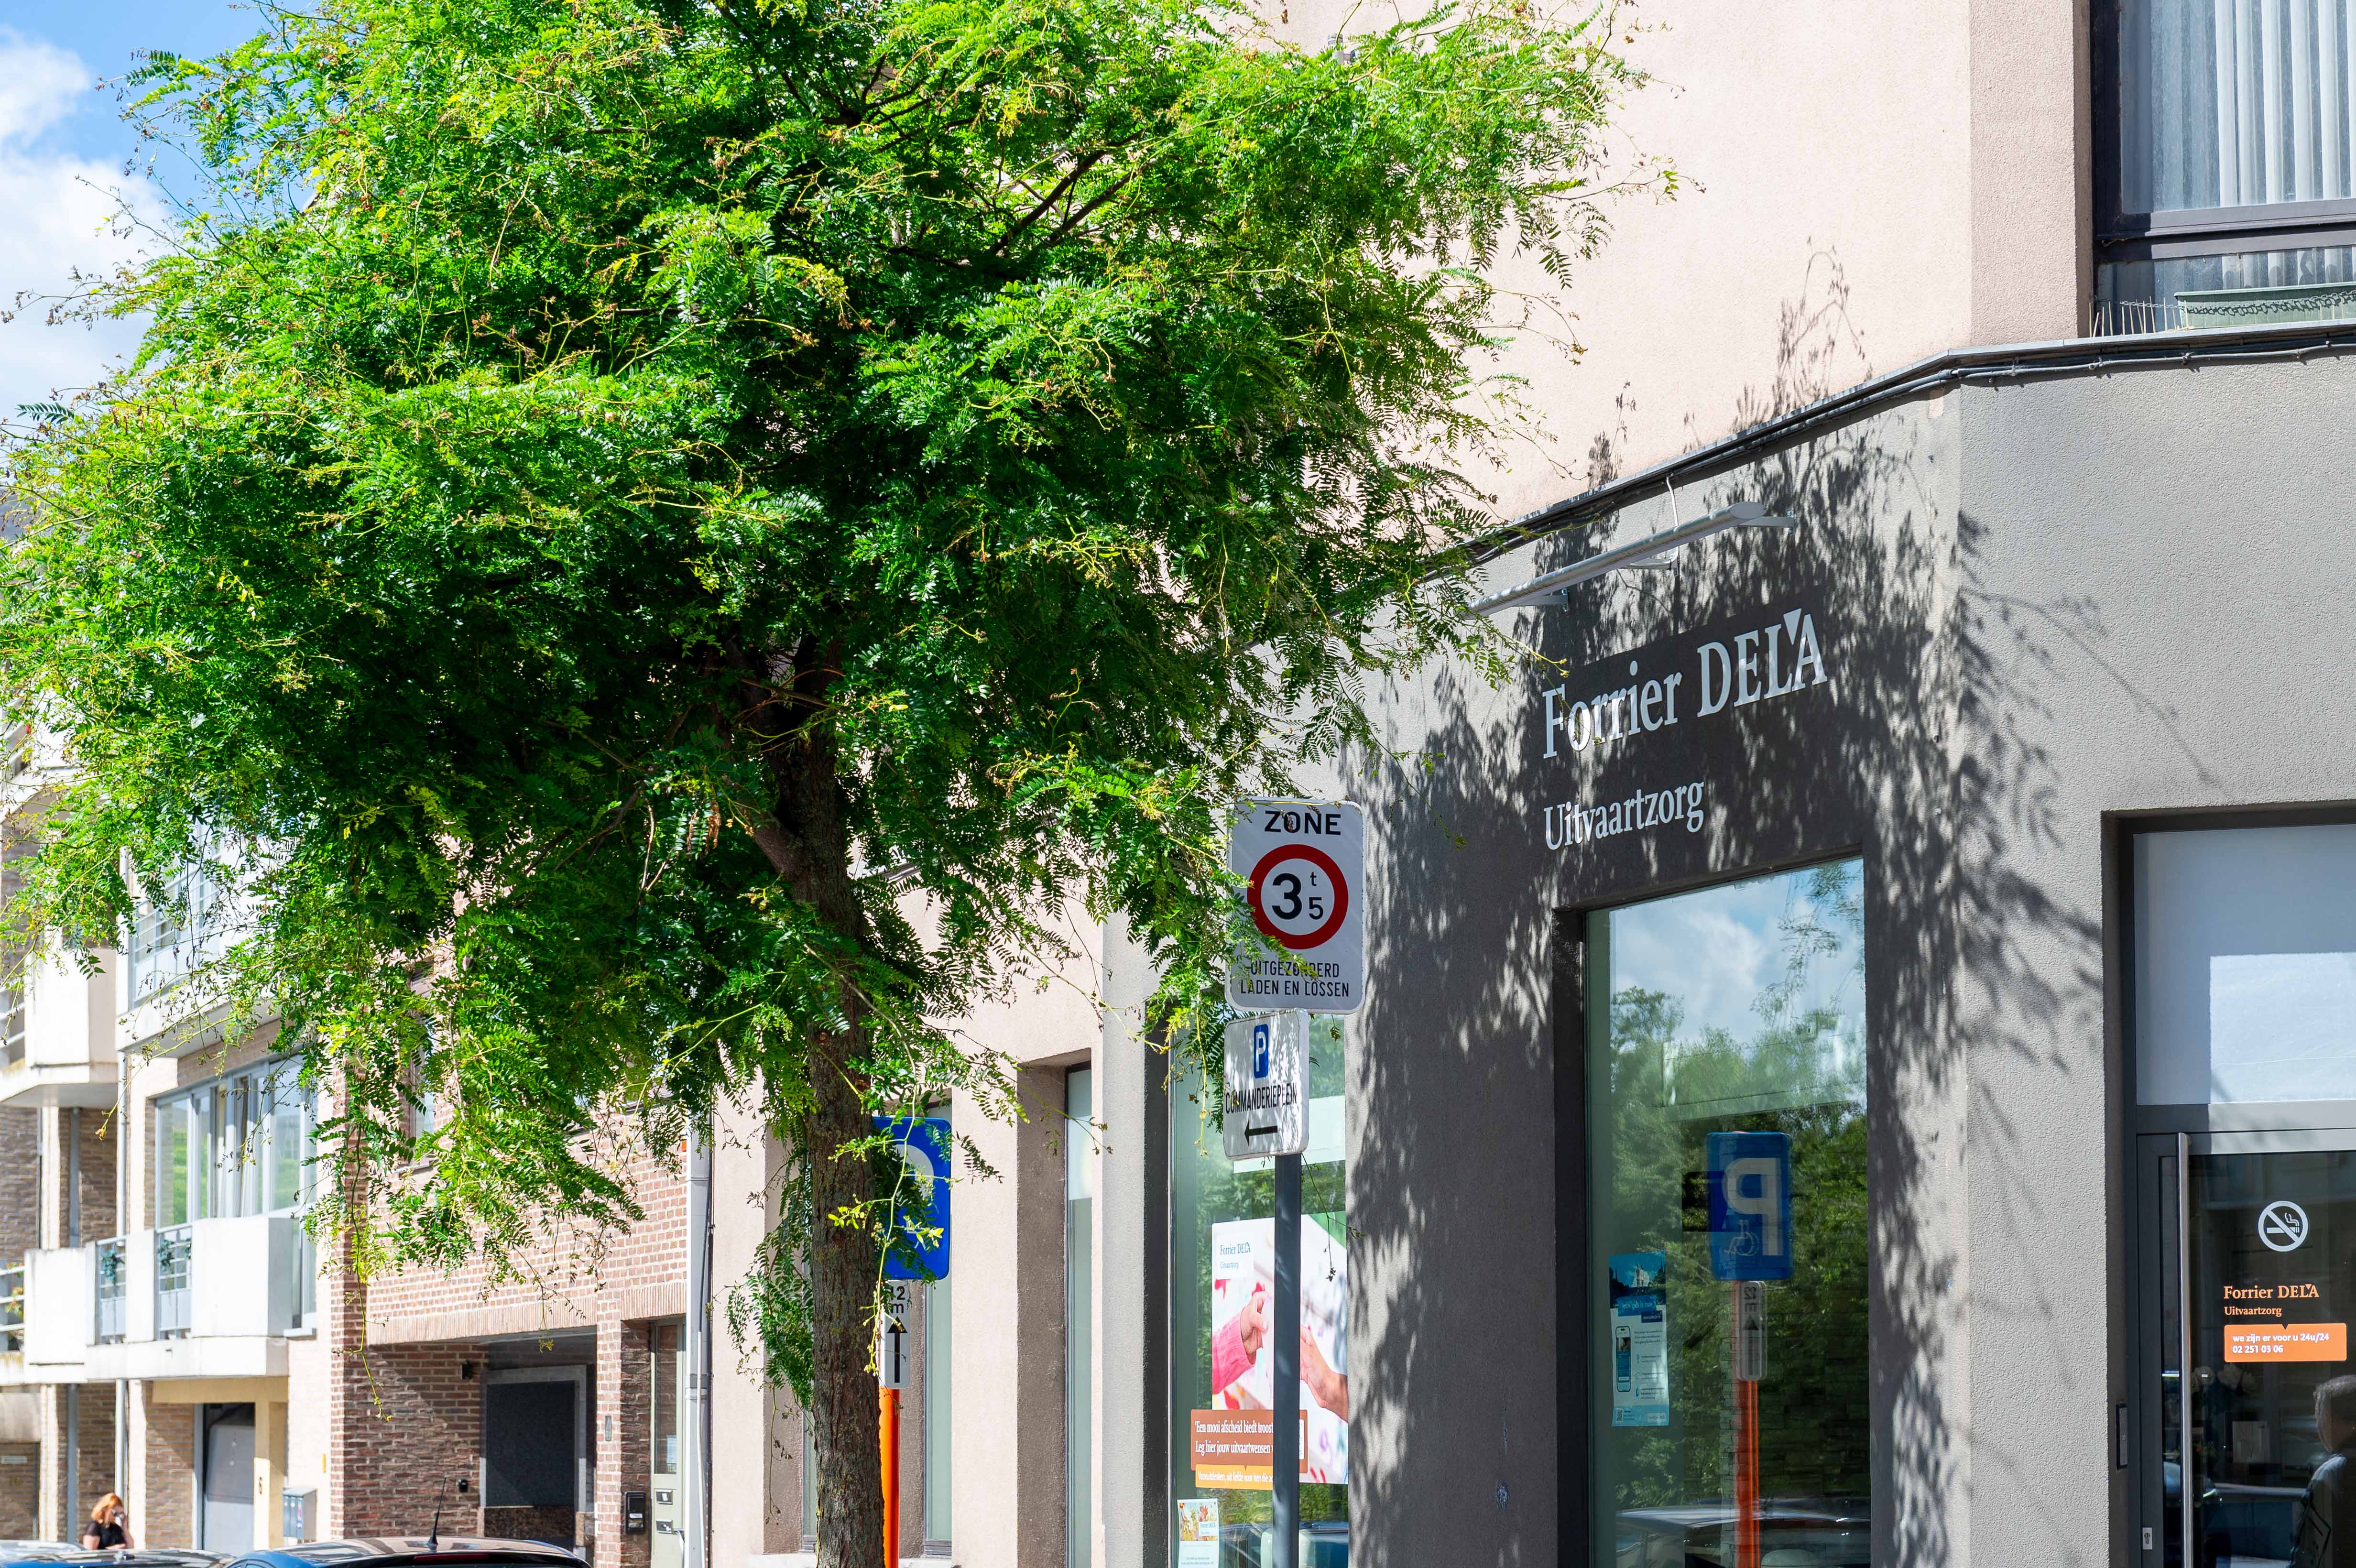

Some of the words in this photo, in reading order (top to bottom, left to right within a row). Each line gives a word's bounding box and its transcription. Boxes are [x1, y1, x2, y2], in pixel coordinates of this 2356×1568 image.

[1542, 660, 1682, 759] Forrier
[1265, 810, 1341, 836] ZONE
[1544, 781, 1705, 850] Uitvaartzorg
[1241, 980, 1279, 995] LADEN
[1285, 980, 1299, 995] EN
[1305, 981, 1350, 997] LOSSEN
[1256, 1031, 1266, 1072] P
[1225, 1082, 1297, 1114] COMMANDERIEPLEIN
[1220, 1244, 1236, 1255] Forrier
[2224, 1285, 2274, 1299] Forrier
[2277, 1284, 2320, 1298] DELA
[2224, 1306, 2282, 1318] Uitvaartzorg
[2246, 1334, 2261, 1344] zijn
[2300, 1333, 2329, 1343] 24u/24
[2261, 1345, 2271, 1353] 03
[1207, 1421, 1220, 1433] mooi
[1221, 1420, 1243, 1433] afscheid
[1244, 1420, 1257, 1433] biedt
[1195, 1440, 1204, 1456] Leg
[1205, 1440, 1216, 1453] hier
[1217, 1440, 1230, 1457] jouw
[1231, 1441, 1270, 1454] uitvaartwensen
[259, 1477, 263, 1494] 6
